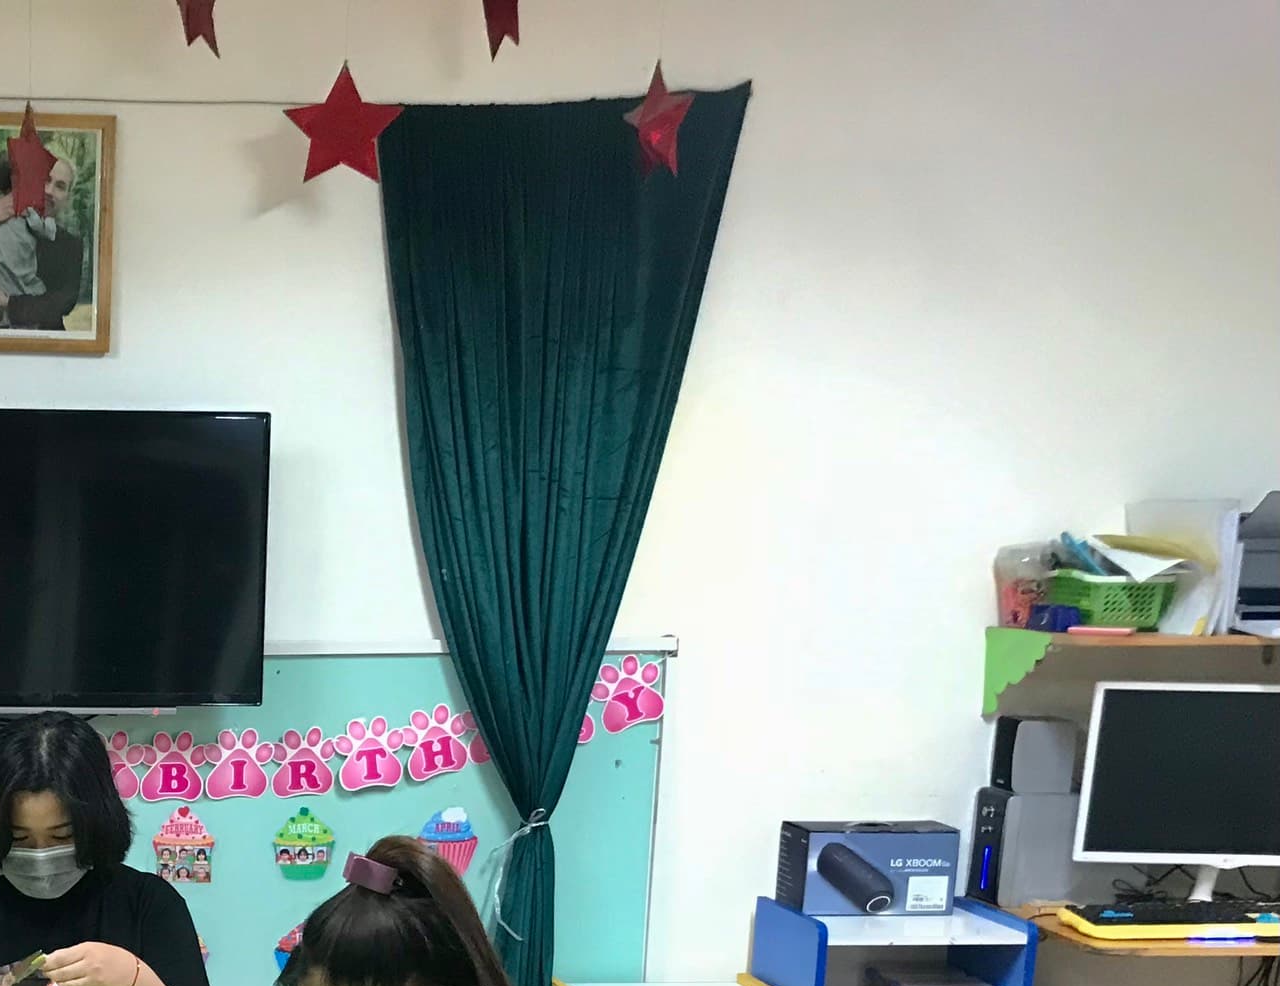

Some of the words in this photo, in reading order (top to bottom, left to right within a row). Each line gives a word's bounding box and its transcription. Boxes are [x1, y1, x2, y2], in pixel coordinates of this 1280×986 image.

[157, 685, 645, 795] BIRTHY
[165, 823, 204, 835] FEBRUARY
[287, 823, 321, 835] MARCH
[434, 822, 461, 833] APRIL
[890, 858, 903, 867] LG
